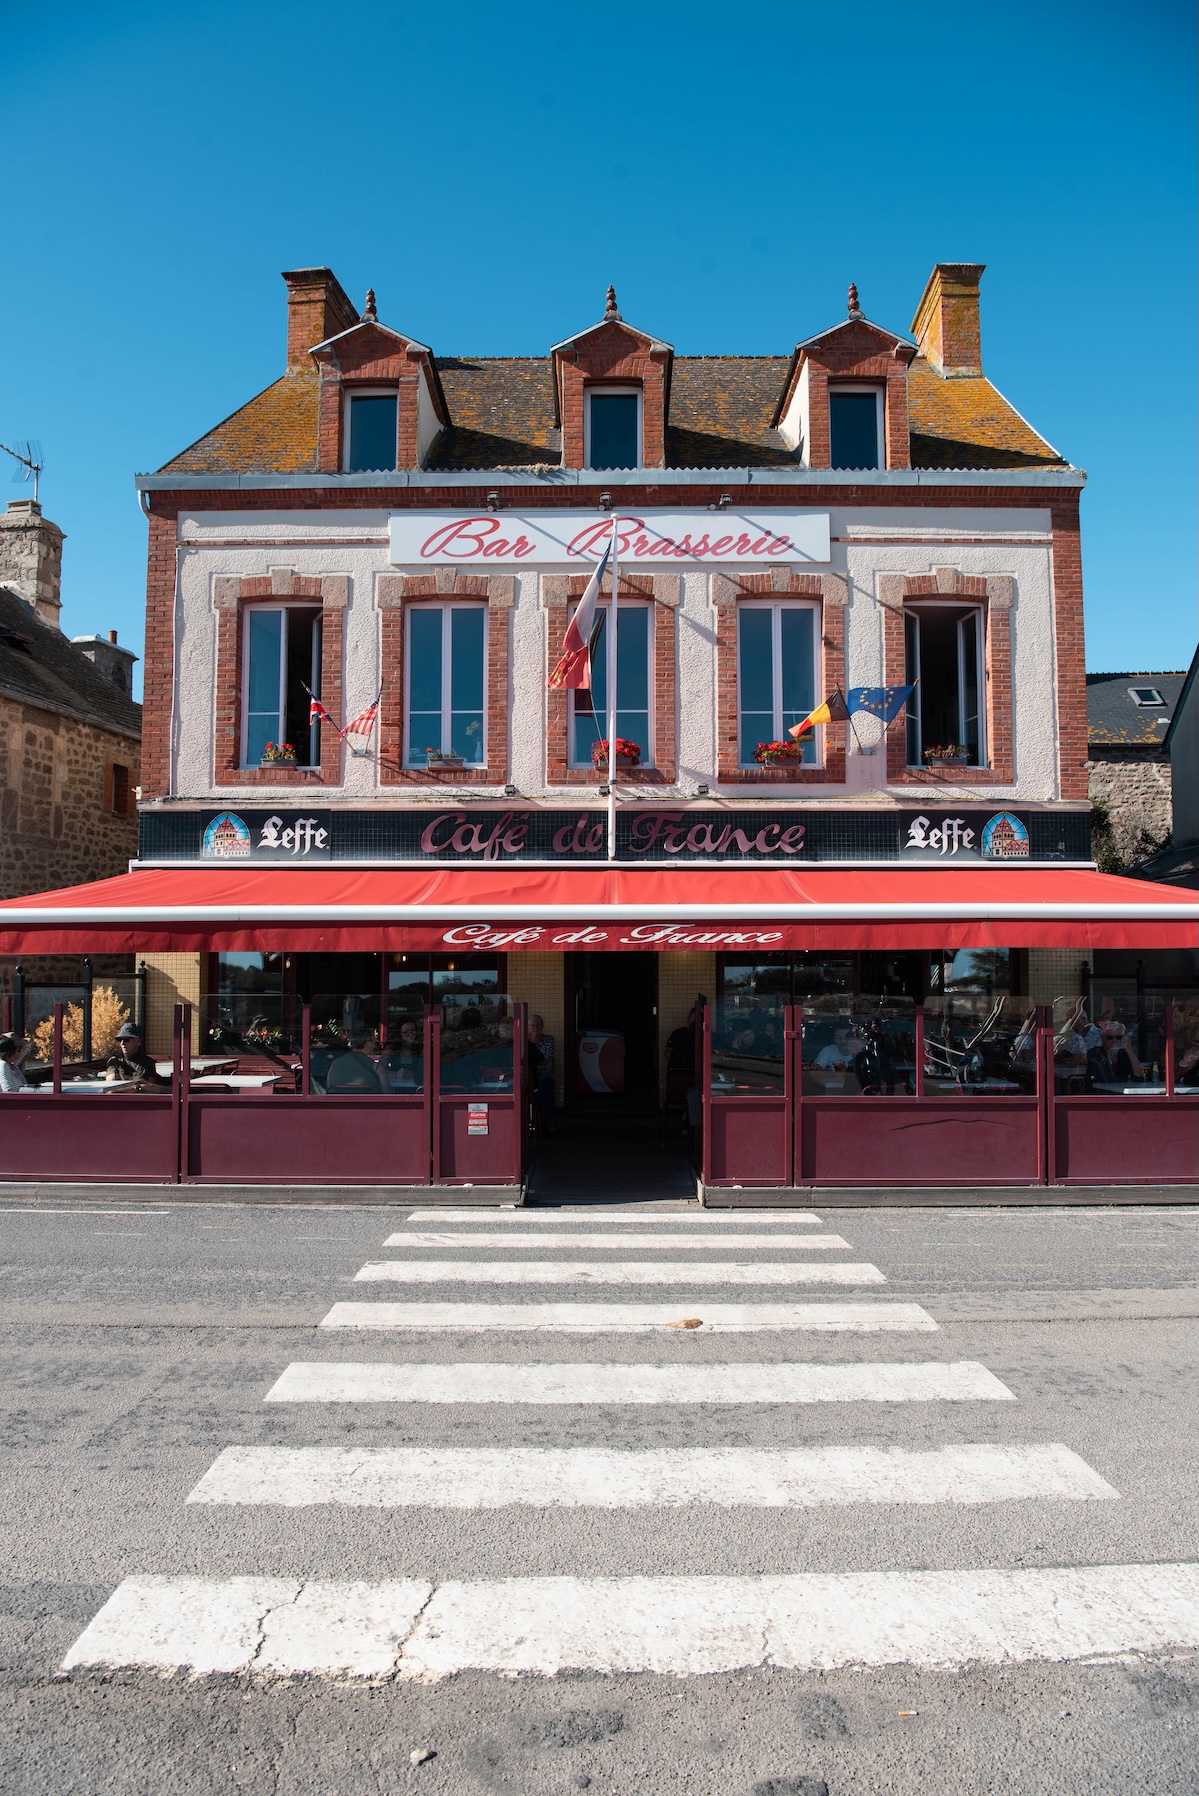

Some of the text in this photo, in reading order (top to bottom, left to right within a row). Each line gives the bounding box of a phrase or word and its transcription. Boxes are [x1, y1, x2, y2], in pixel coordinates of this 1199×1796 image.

[420, 517, 795, 558] Bar Brasserie
[256, 815, 329, 856] Leffe
[420, 810, 806, 861] Café de France
[904, 815, 976, 856] Leffe
[443, 923, 783, 950] Café de France
